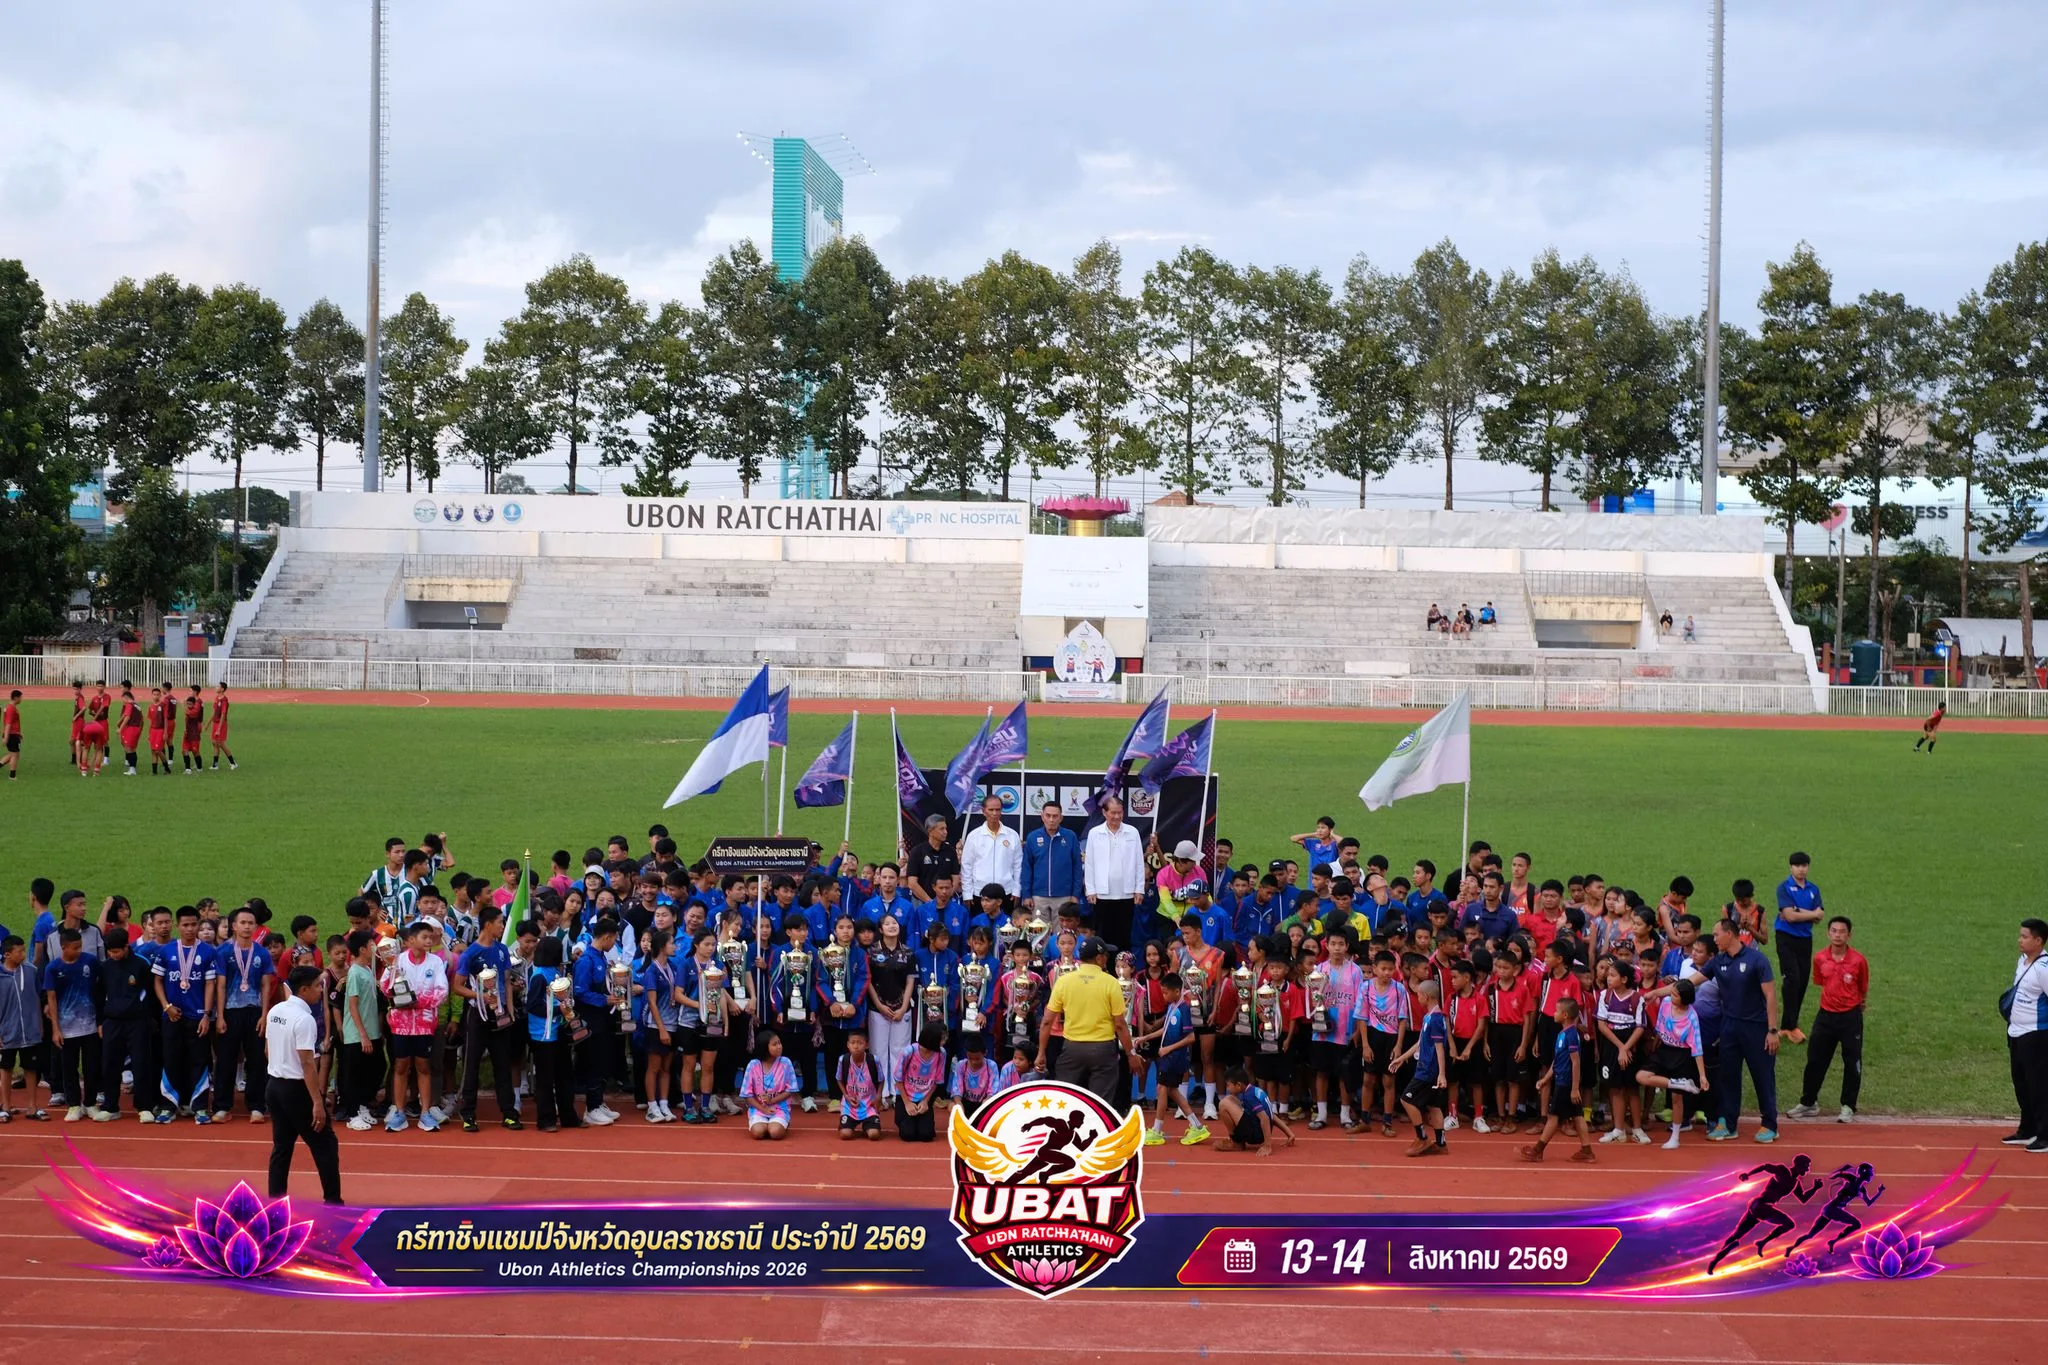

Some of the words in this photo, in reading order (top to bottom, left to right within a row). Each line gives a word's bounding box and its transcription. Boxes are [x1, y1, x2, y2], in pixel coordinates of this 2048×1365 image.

[627, 503, 704, 529] UBON
[961, 512, 1022, 525] HOSPITAL
[1602, 1065, 1610, 1079] 6
